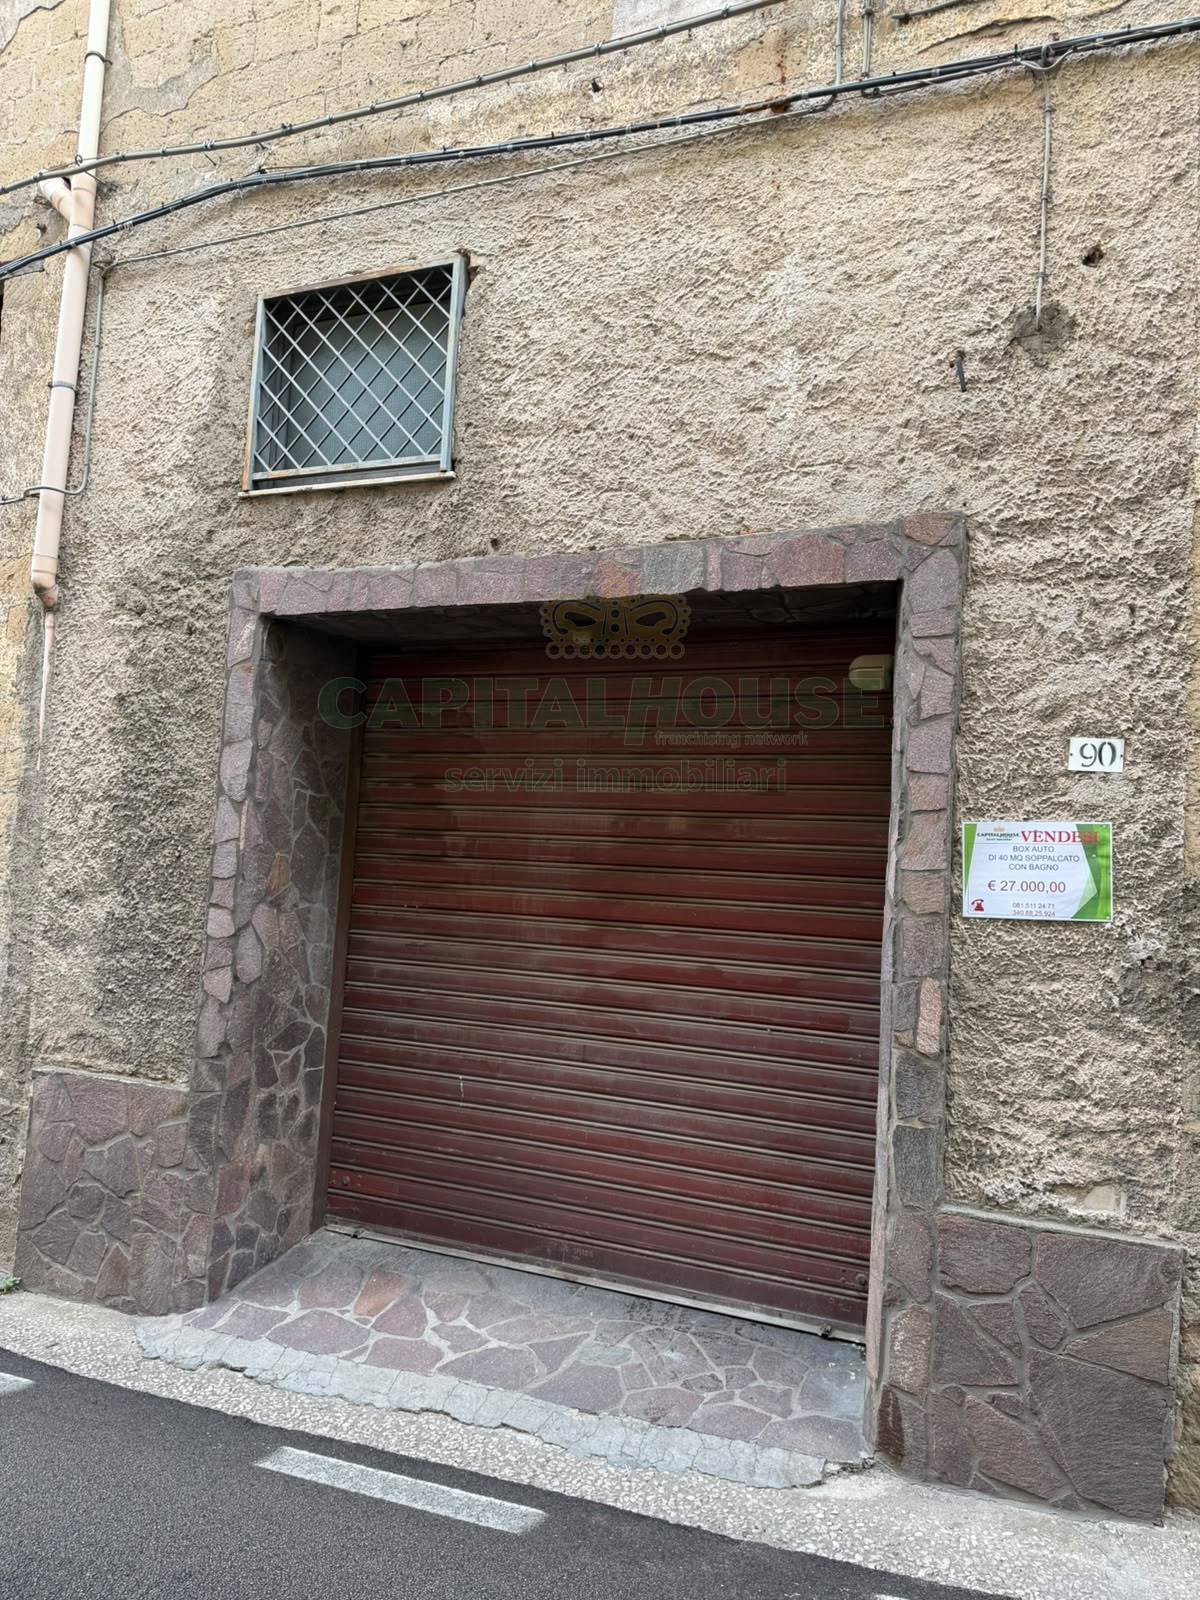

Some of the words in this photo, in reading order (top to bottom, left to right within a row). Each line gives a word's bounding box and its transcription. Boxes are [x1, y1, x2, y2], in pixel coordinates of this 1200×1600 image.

[1079, 741, 1116, 767] 90
[1020, 830, 1099, 843] VENDESI
[1031, 845, 1055, 853] AUTO
[1009, 854, 1024, 862] MQ
[1025, 854, 1080, 863] SOPPALCATO
[1029, 863, 1059, 871] BAGNO
[987, 880, 996, 891] €
[1000, 880, 1066, 893] 27.000,00
